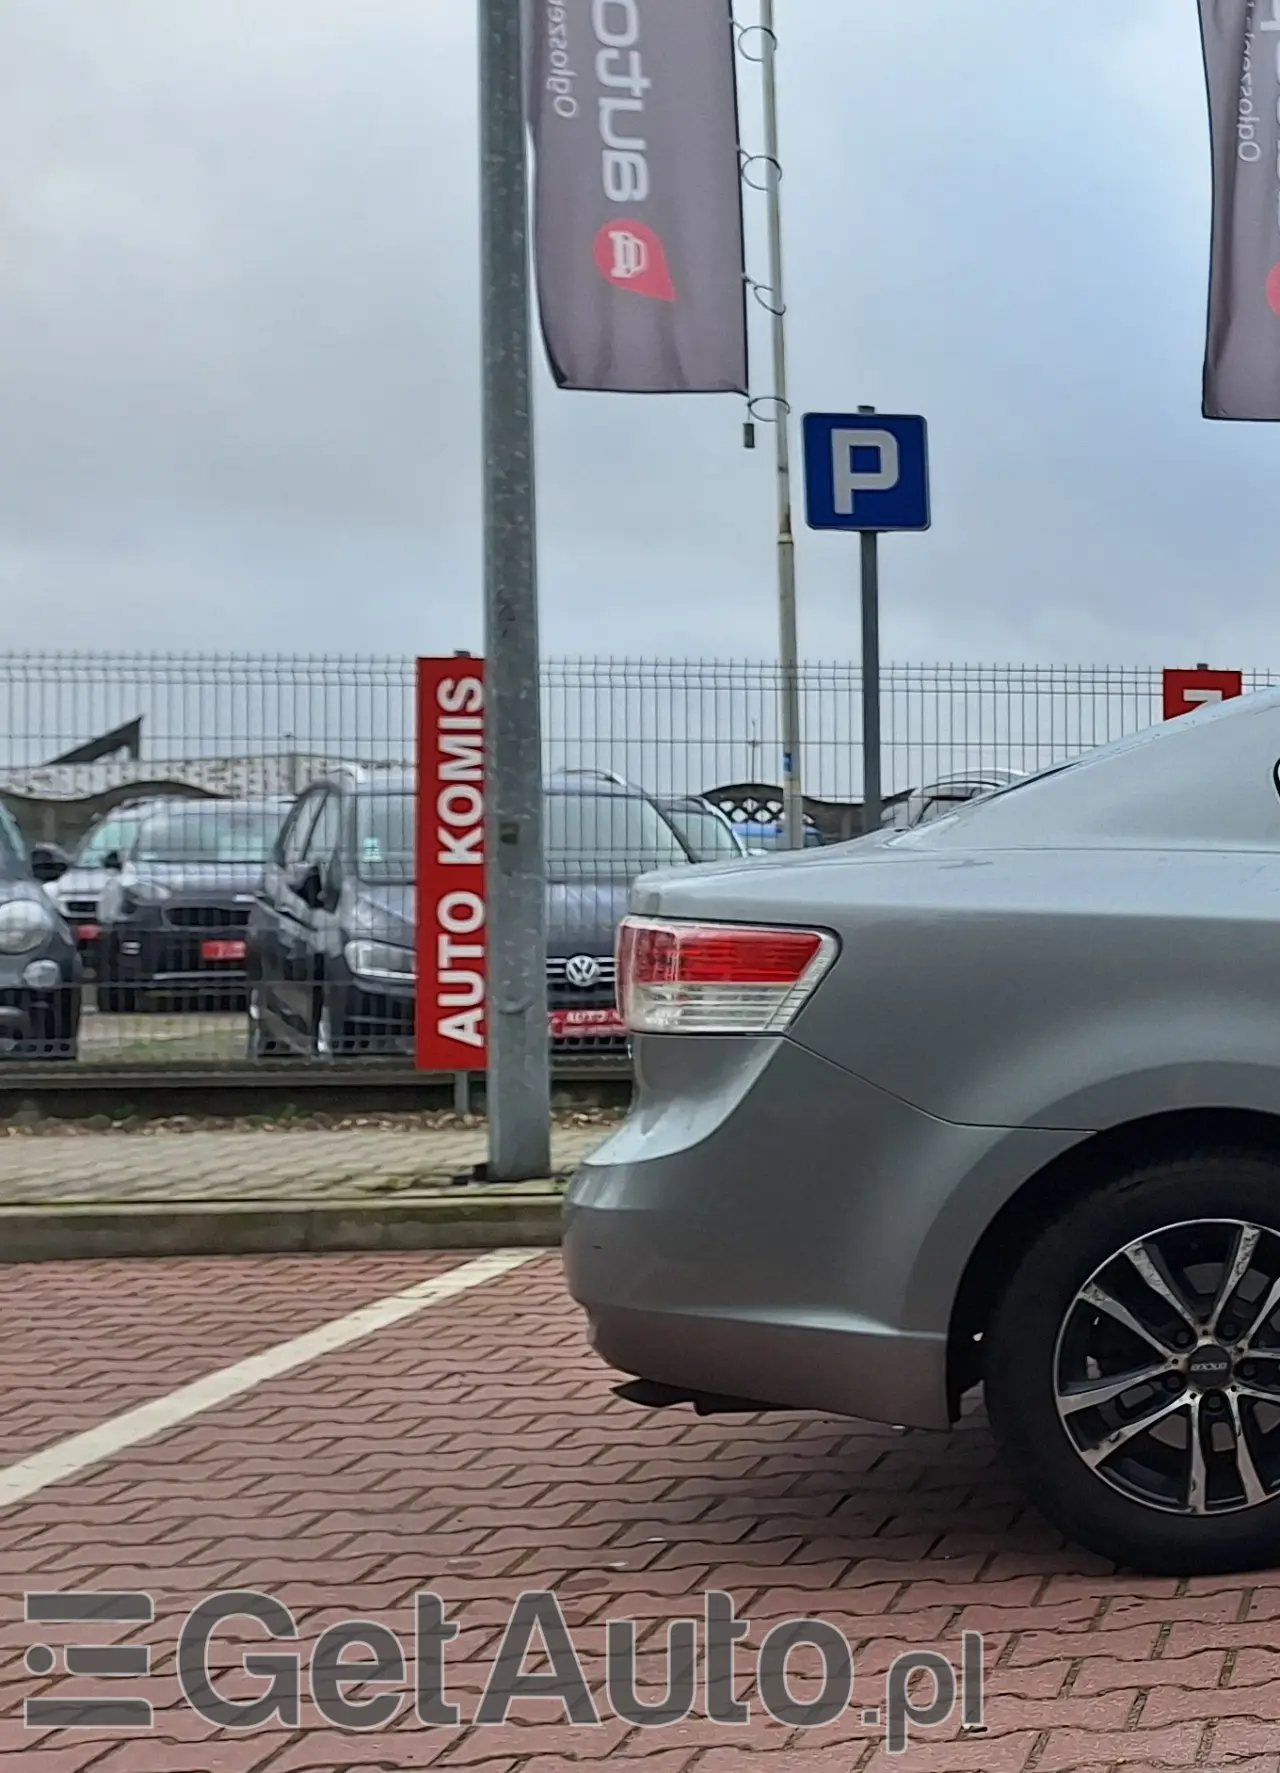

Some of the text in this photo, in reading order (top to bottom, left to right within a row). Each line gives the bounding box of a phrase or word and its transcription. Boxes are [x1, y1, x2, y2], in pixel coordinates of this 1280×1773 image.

[831, 428, 899, 515] P
[437, 676, 485, 1048] AUTO KOMIS
